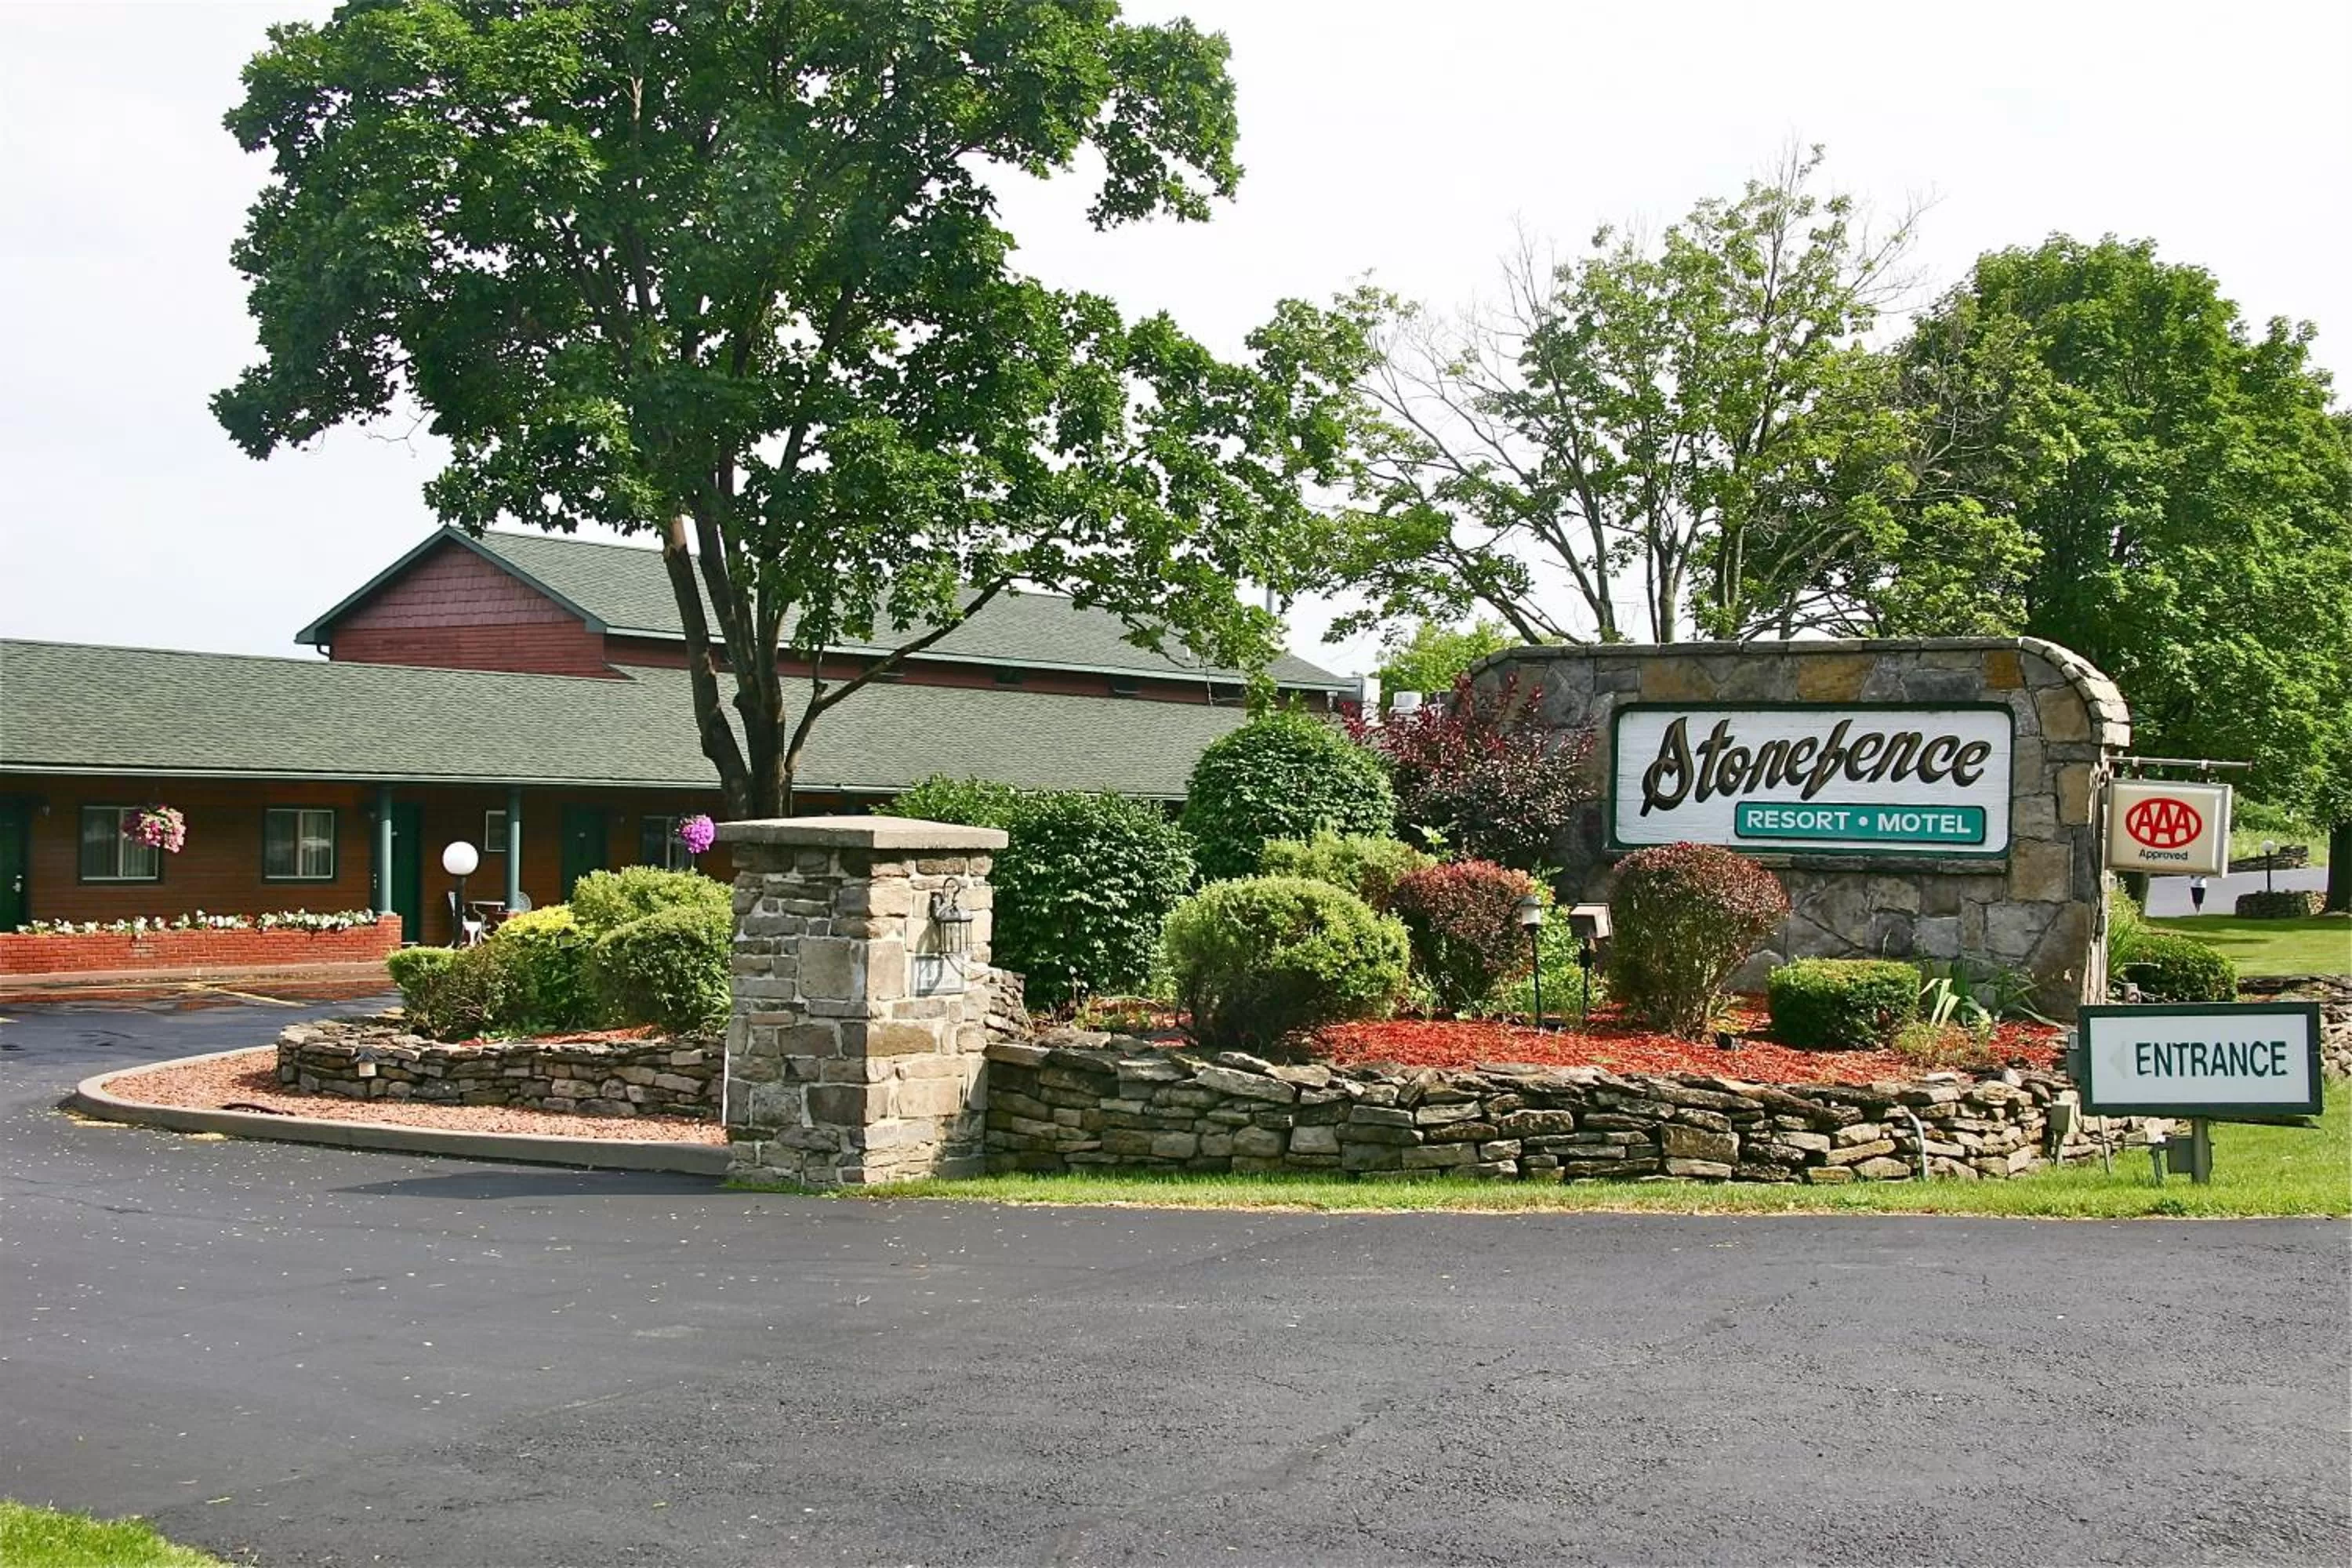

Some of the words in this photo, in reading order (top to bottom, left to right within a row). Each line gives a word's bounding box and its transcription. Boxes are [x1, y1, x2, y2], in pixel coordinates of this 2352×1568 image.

[1640, 717, 1991, 817] Stonefence
[1747, 810, 1850, 831] RESORT
[1878, 812, 1972, 834] MOTEL
[2133, 800, 2194, 847] AAA
[2139, 849, 2188, 860] Approved
[2136, 1041, 2288, 1077] ENTRANCE
